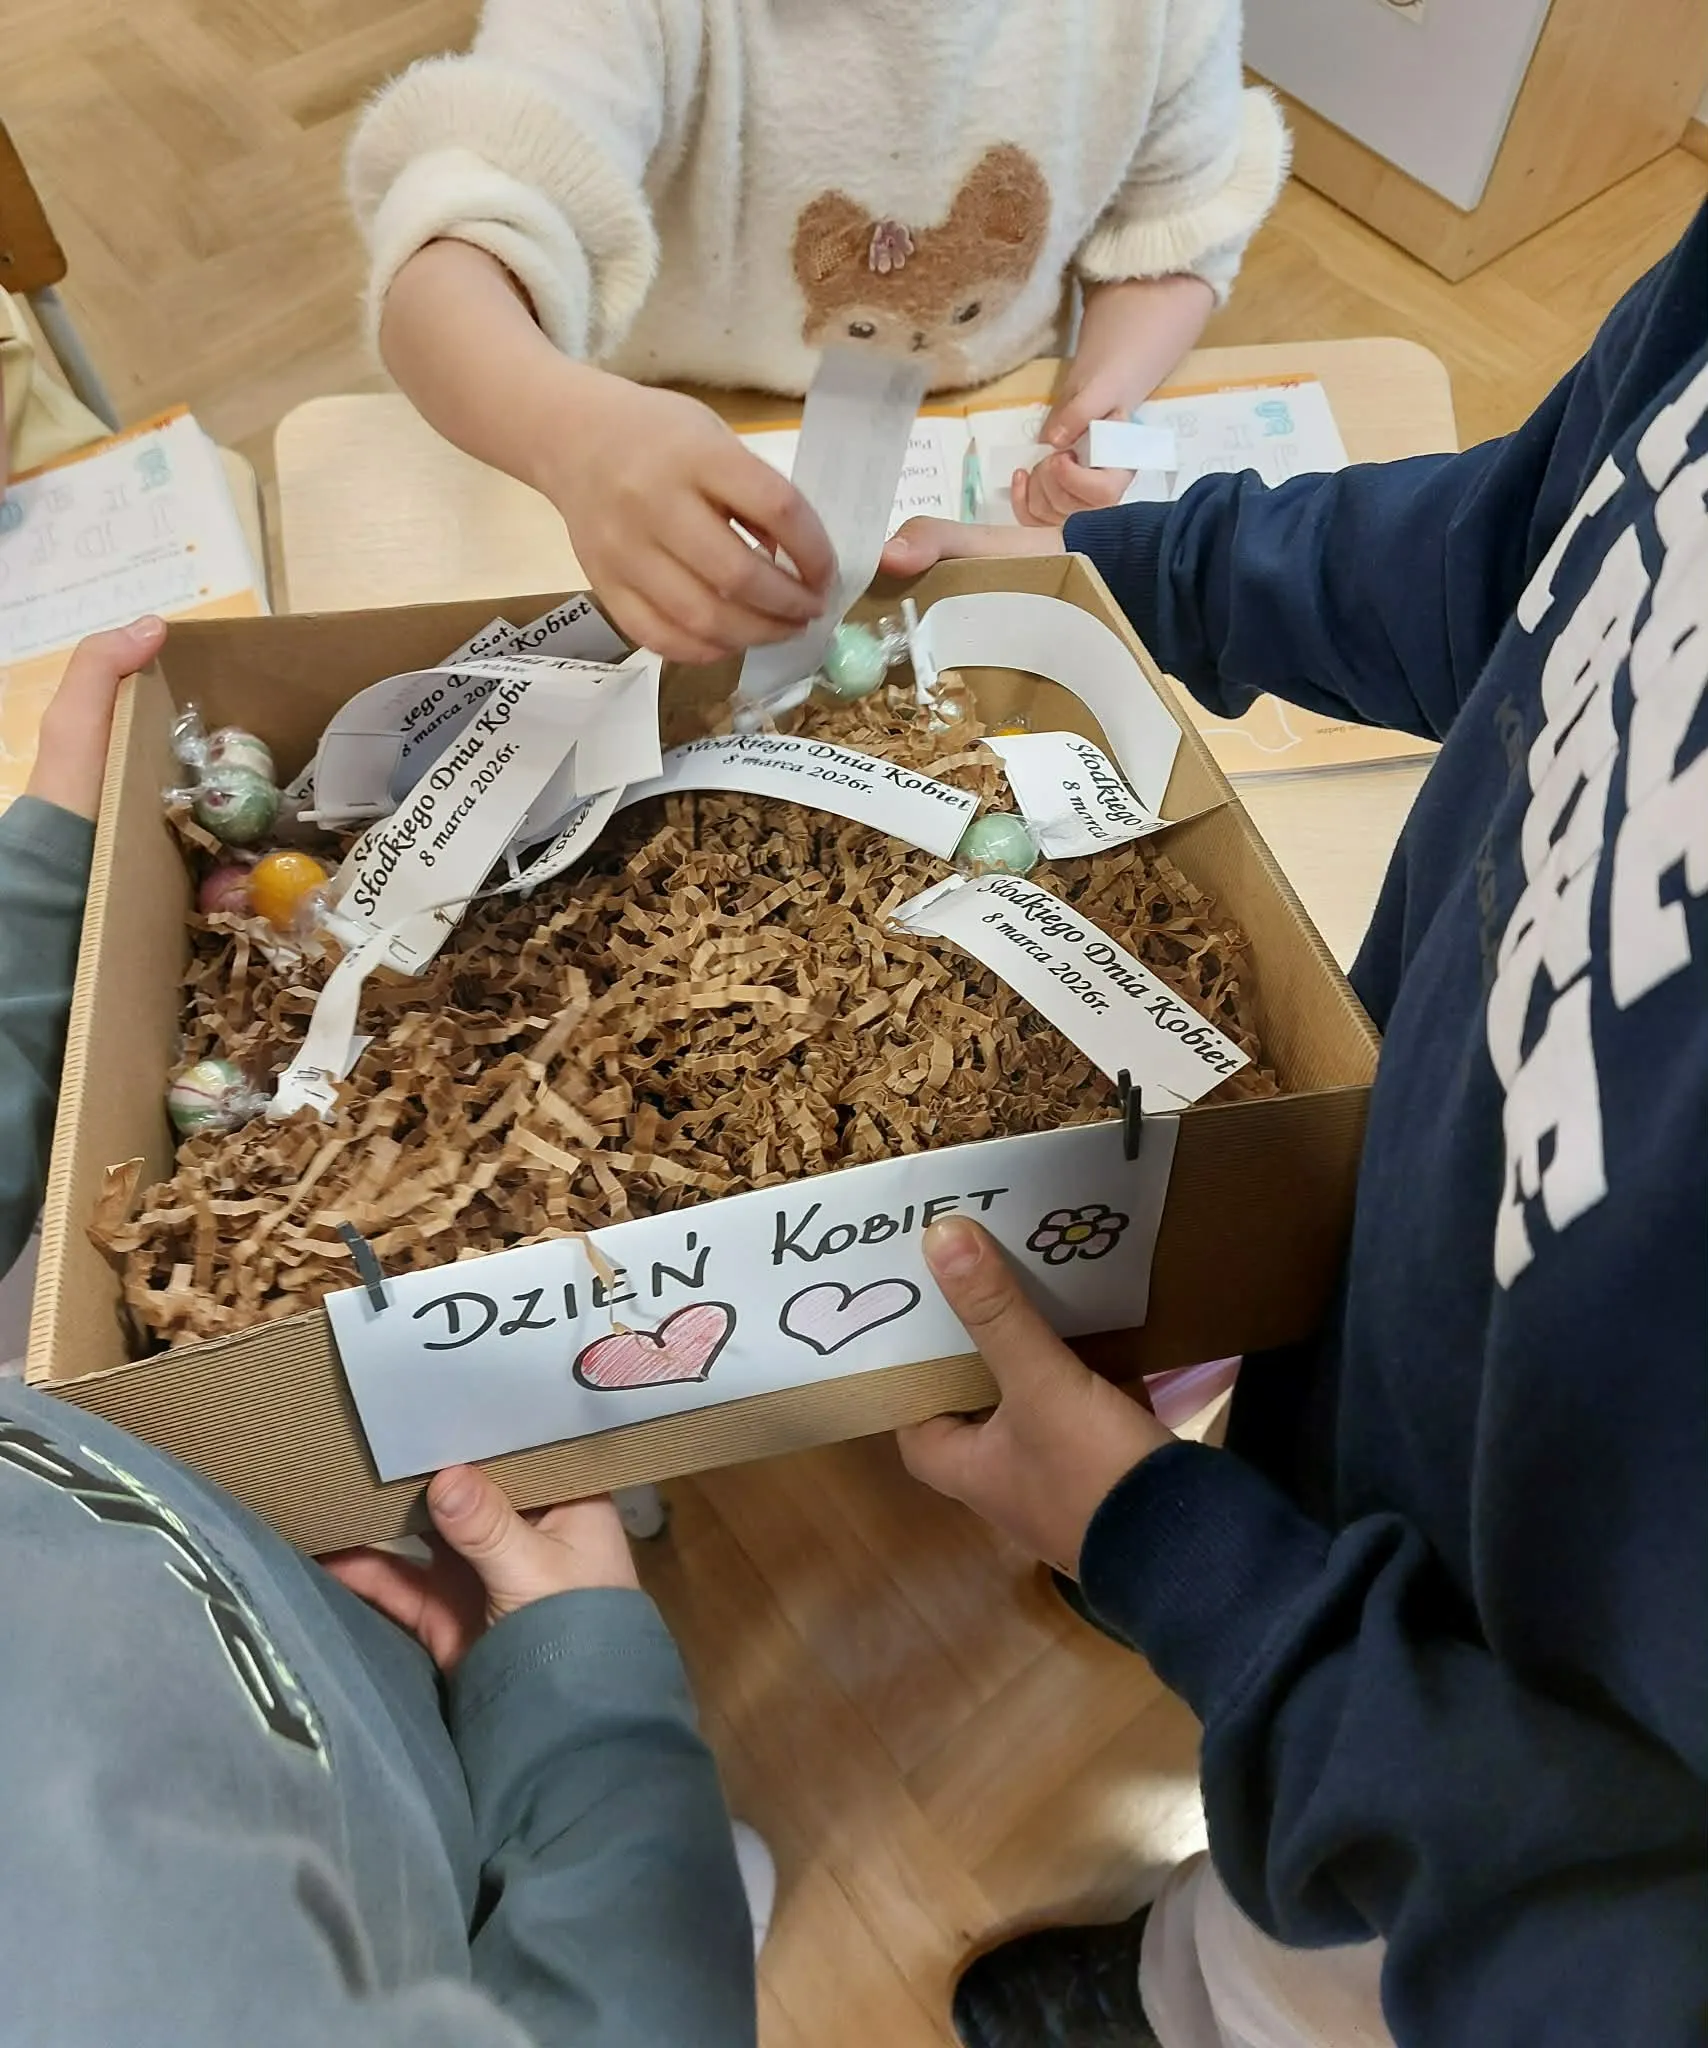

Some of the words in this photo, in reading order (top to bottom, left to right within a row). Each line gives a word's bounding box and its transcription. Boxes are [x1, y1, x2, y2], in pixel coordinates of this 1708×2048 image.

[508, 600, 592, 653] Kobiet
[413, 702, 462, 744] marca
[464, 678, 503, 705] 202
[354, 794, 436, 916] Słodkiego
[430, 737, 484, 790] Dnia
[476, 679, 532, 736] Kobi
[419, 850, 436, 867] 8
[433, 795, 477, 850] marca
[471, 743, 521, 794] 2026r.
[722, 754, 740, 765] 8
[741, 757, 804, 772] marca
[807, 766, 874, 795] 2026r.
[808, 743, 876, 774] Dnia
[883, 766, 971, 812] Kobiet
[1062, 780, 1081, 791] 8
[1066, 743, 1142, 826] Słodkiego
[976, 879, 1086, 943] Słodkiego
[1082, 942, 1151, 999] Dnia
[1144, 995, 1239, 1075] Kobiet
[981, 912, 1004, 924] 8
[995, 921, 1054, 964] marca
[1047, 962, 1110, 1015] 2026r.
[412, 1231, 711, 1351] DZIEŃ
